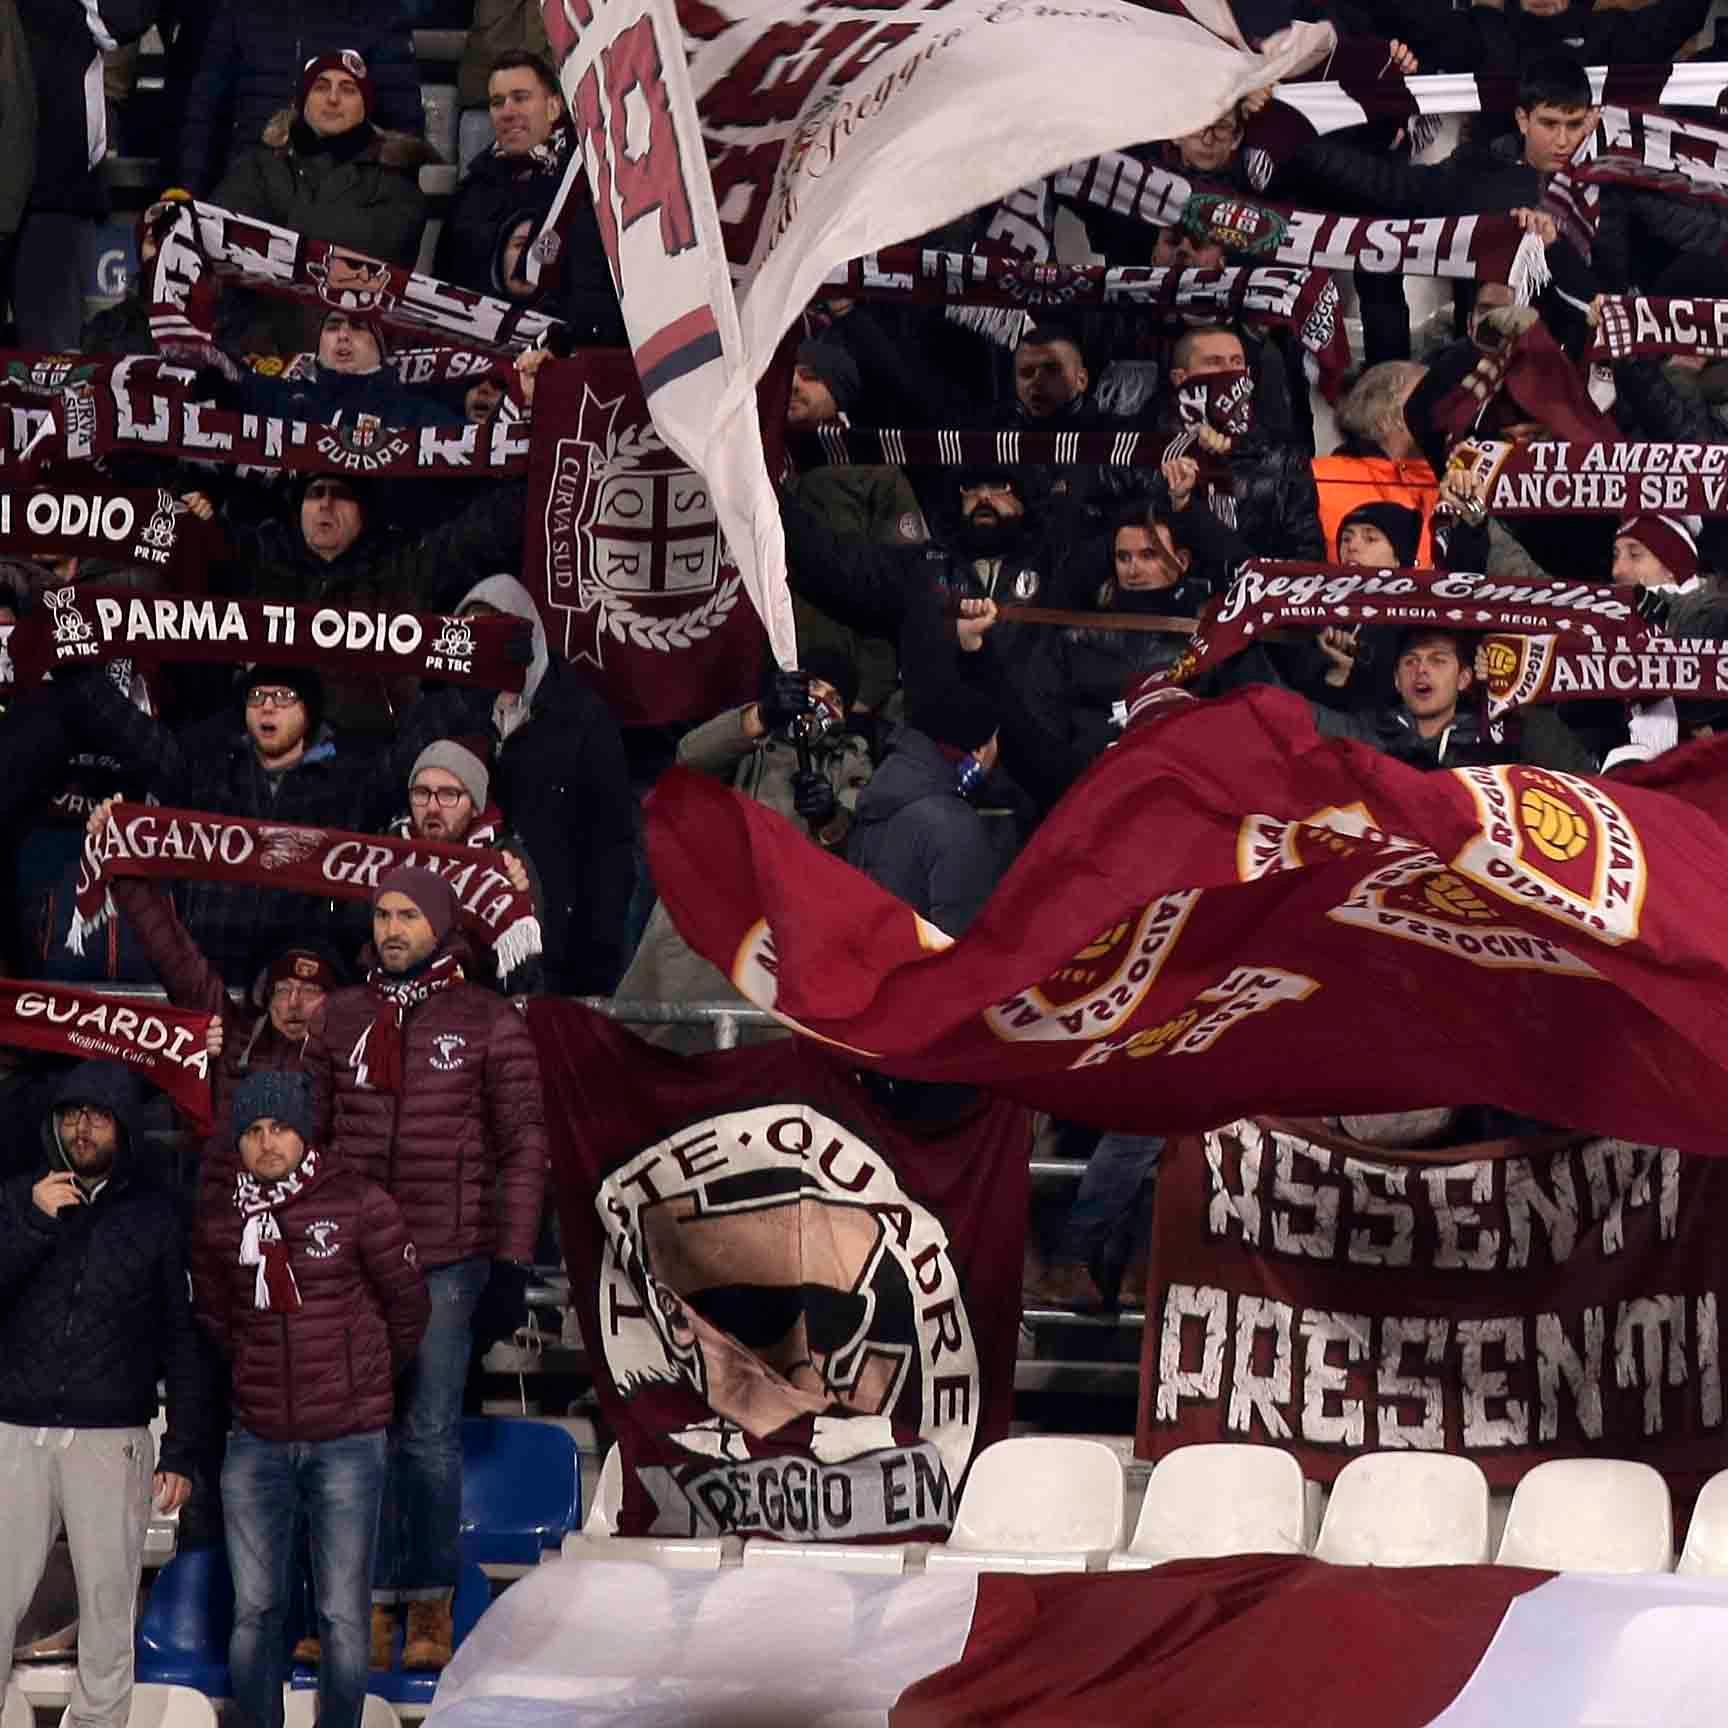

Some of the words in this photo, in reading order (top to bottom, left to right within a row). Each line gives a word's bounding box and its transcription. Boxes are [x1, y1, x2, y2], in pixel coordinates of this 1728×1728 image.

[1275, 210, 1480, 280] TESTE
[1633, 296, 1708, 344] A.C.
[1527, 440, 1572, 473] TI
[553, 455, 582, 535] CURVA
[606, 488, 644, 519] Q
[673, 489, 707, 512] S
[1491, 472, 1627, 510] ANCHE
[1639, 472, 1690, 510] SE
[26, 493, 136, 544] ODIO
[134, 543, 151, 562] PR
[554, 535, 575, 589] SUD
[607, 551, 640, 577] R
[671, 550, 705, 574] P
[1216, 567, 1418, 623] Reggio
[1430, 570, 1634, 621] Emilia
[1279, 606, 1327, 618] REGIA
[1386, 606, 1438, 619] REGIA
[1501, 613, 1549, 626] REGIA
[97, 597, 249, 643] PARMA
[263, 602, 296, 646] TI
[311, 608, 424, 656] ODIO
[56, 641, 74, 658] PR
[75, 640, 99, 656] TBC
[426, 655, 444, 672] PR
[445, 656, 472, 673] TBC
[1549, 655, 1702, 694] ANCHE
[15, 992, 209, 1080] GUARDIA
[1203, 1118, 1681, 1272] ASSENTI
[765, 1116, 970, 1429] QUADRE
[1155, 1282, 1722, 1450] PRESENTI
